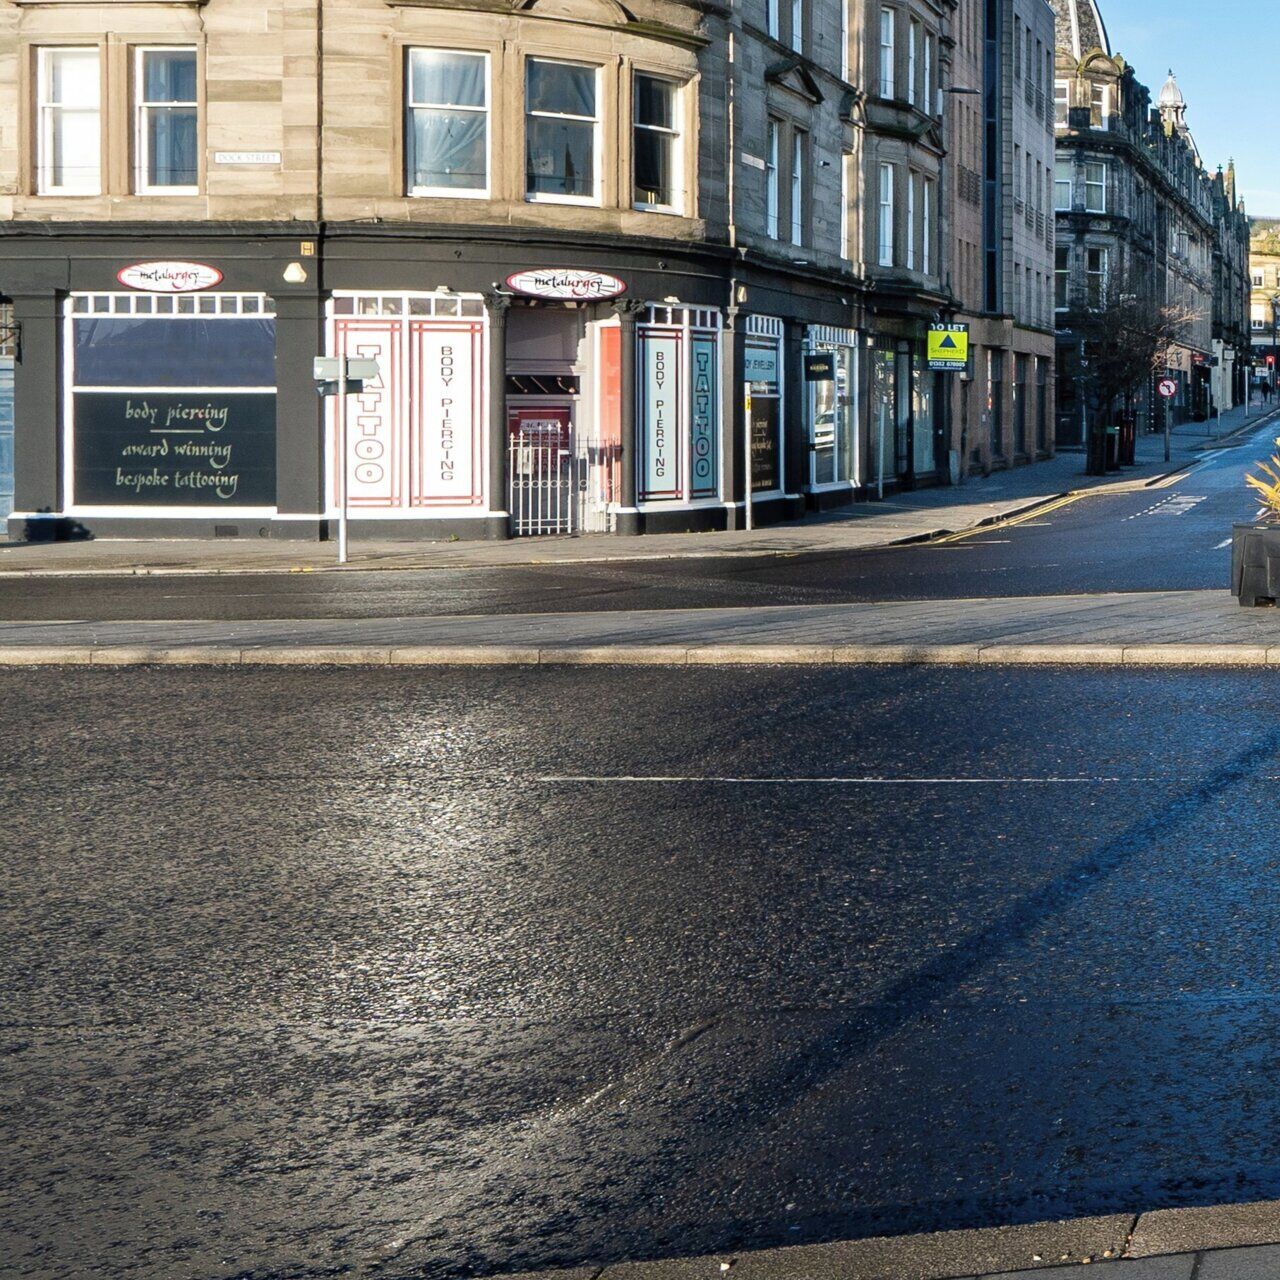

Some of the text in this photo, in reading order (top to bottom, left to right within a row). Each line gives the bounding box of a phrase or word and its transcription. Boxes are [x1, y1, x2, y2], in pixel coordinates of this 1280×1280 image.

[947, 324, 965, 332] LET
[125, 400, 229, 431] body piercing
[440, 346, 454, 481] BODY PIERCING
[655, 351, 665, 477] BODY PIERCING
[695, 352, 710, 478] TATTOO
[122, 438, 232, 469] award winning
[116, 467, 239, 499] bespoke tattooing
